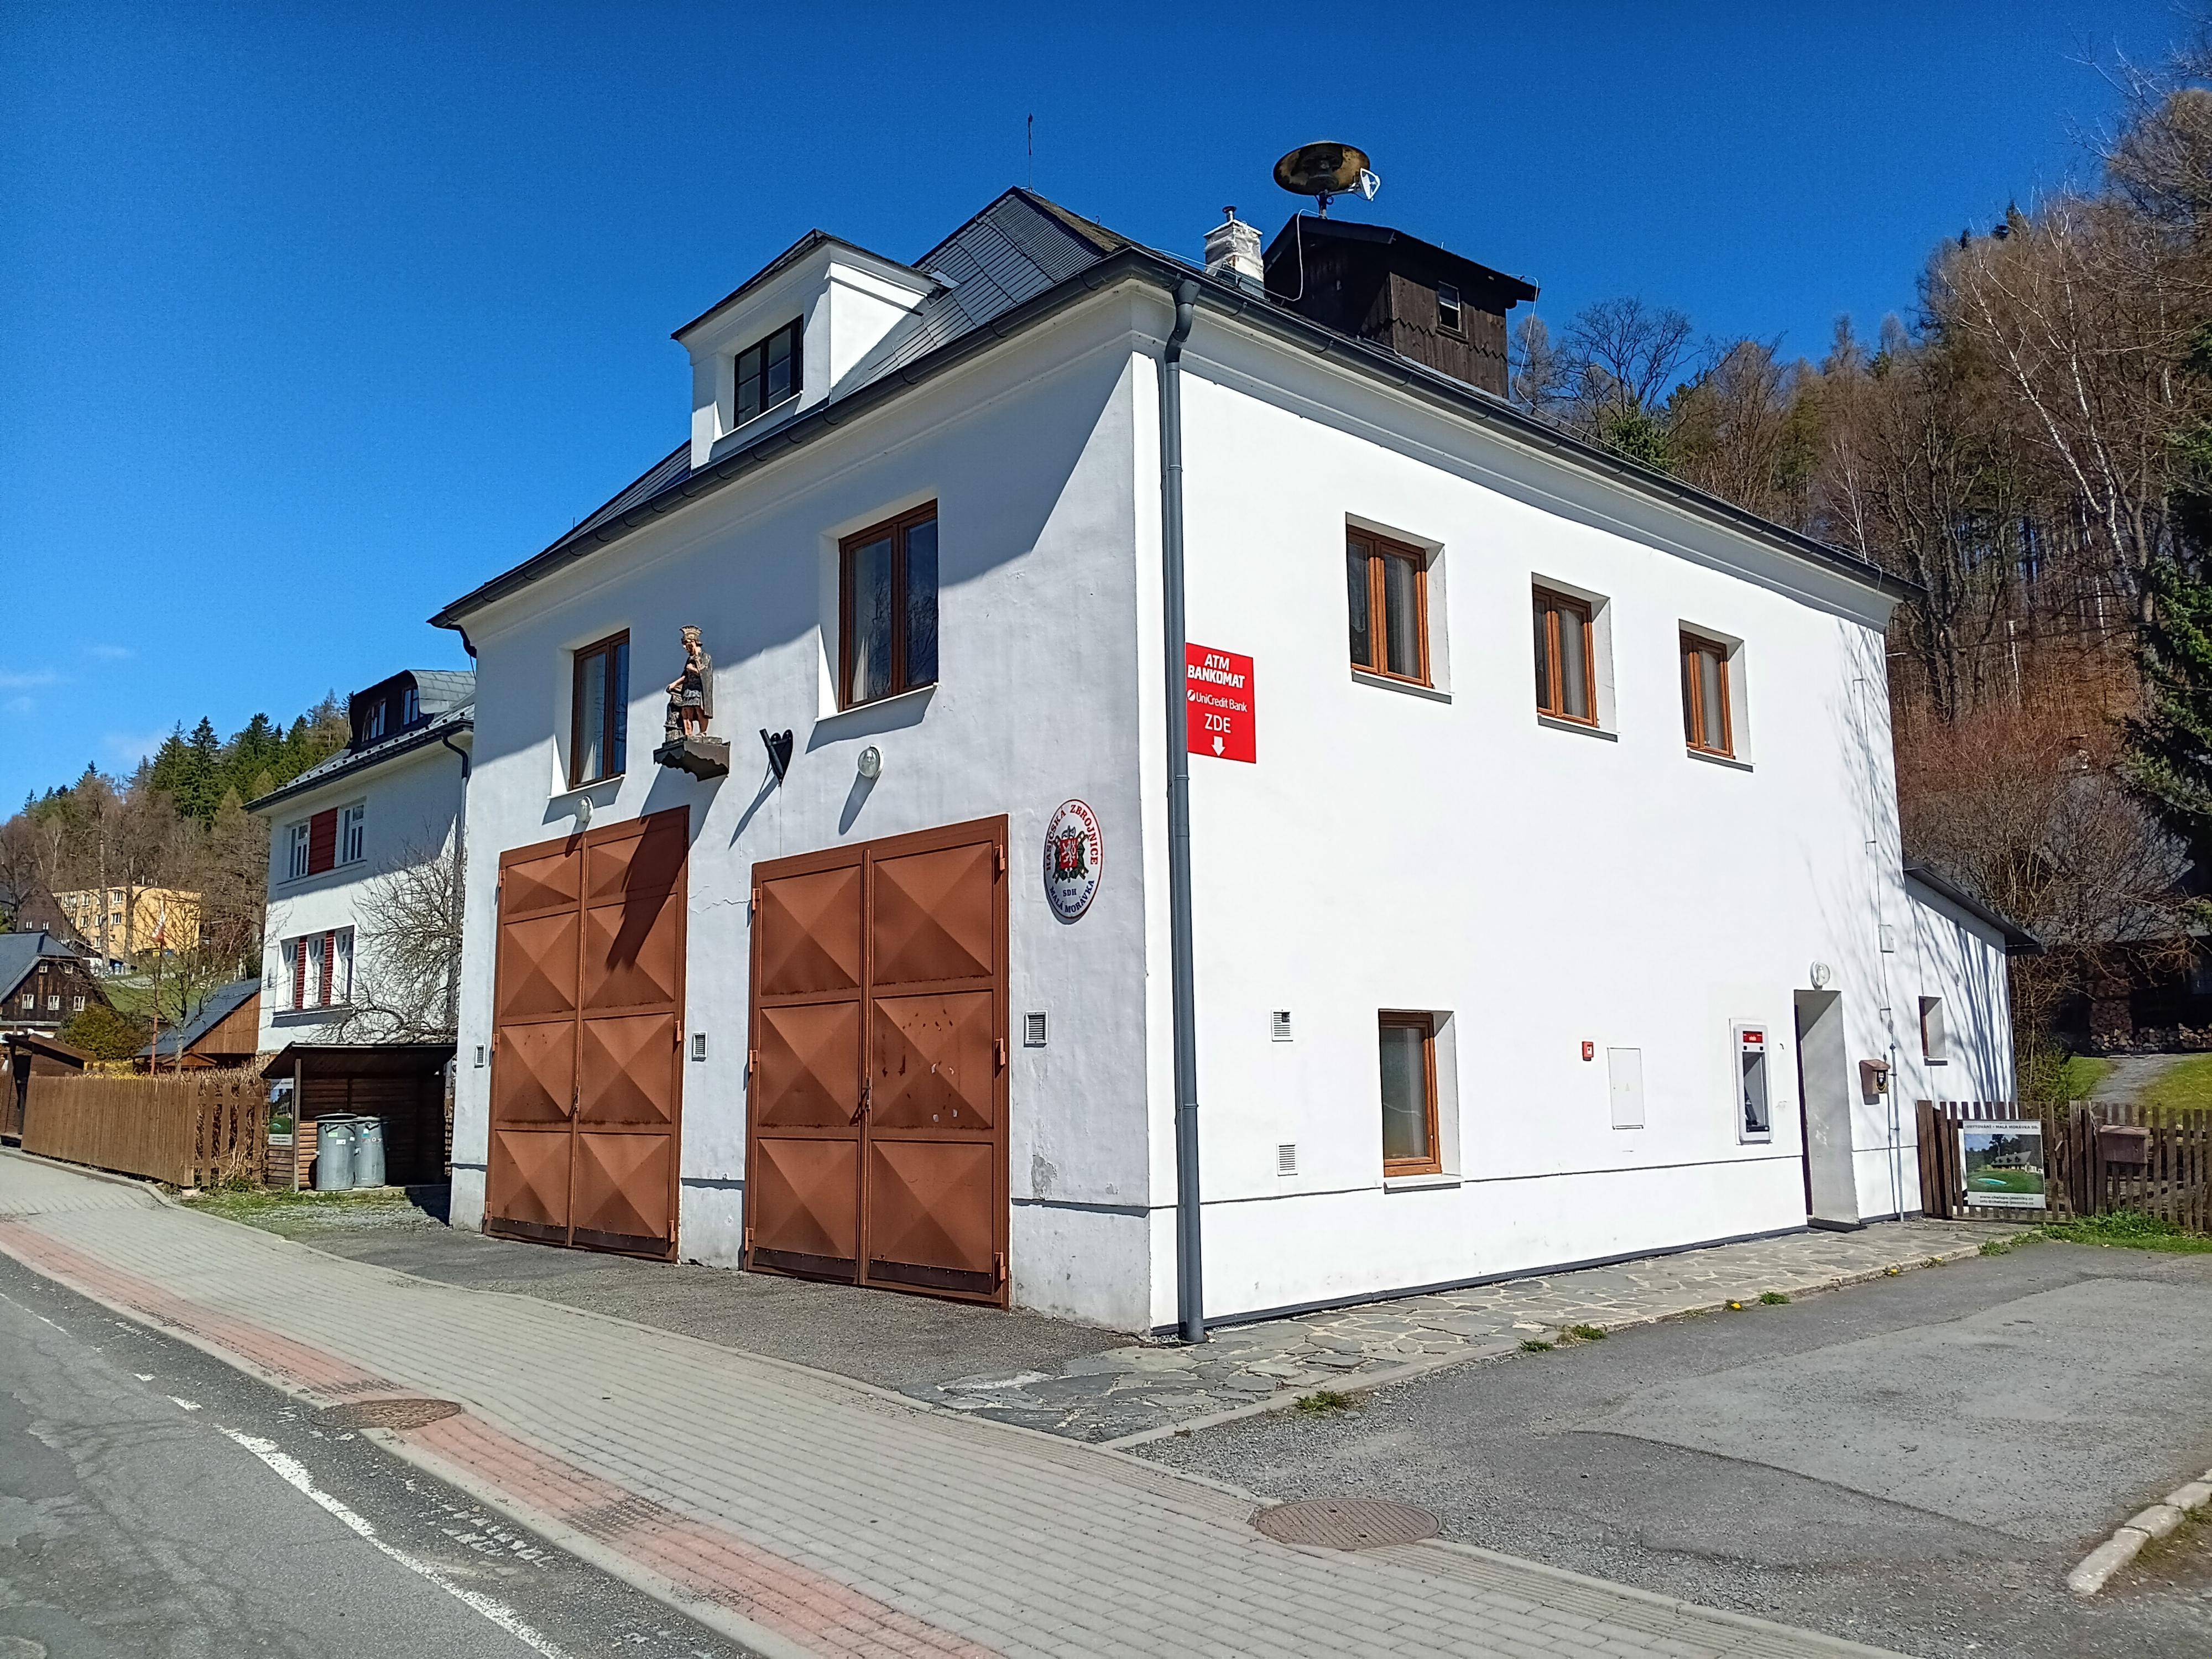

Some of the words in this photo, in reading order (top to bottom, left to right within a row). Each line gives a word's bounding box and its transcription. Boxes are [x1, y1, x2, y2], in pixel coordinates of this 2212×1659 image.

[1204, 654, 1230, 671] ATM
[1187, 665, 1245, 688] BANKOMAT
[1196, 692, 1228, 708] UniCredit
[1229, 699, 1248, 712] Bank
[1204, 713, 1232, 733] ZDE
[1070, 805, 1098, 864] ZBROJNICE
[1050, 886, 1064, 910] MALÁ
[1065, 880, 1094, 913] MORÁVKA
[1062, 888, 1077, 896] SDH
